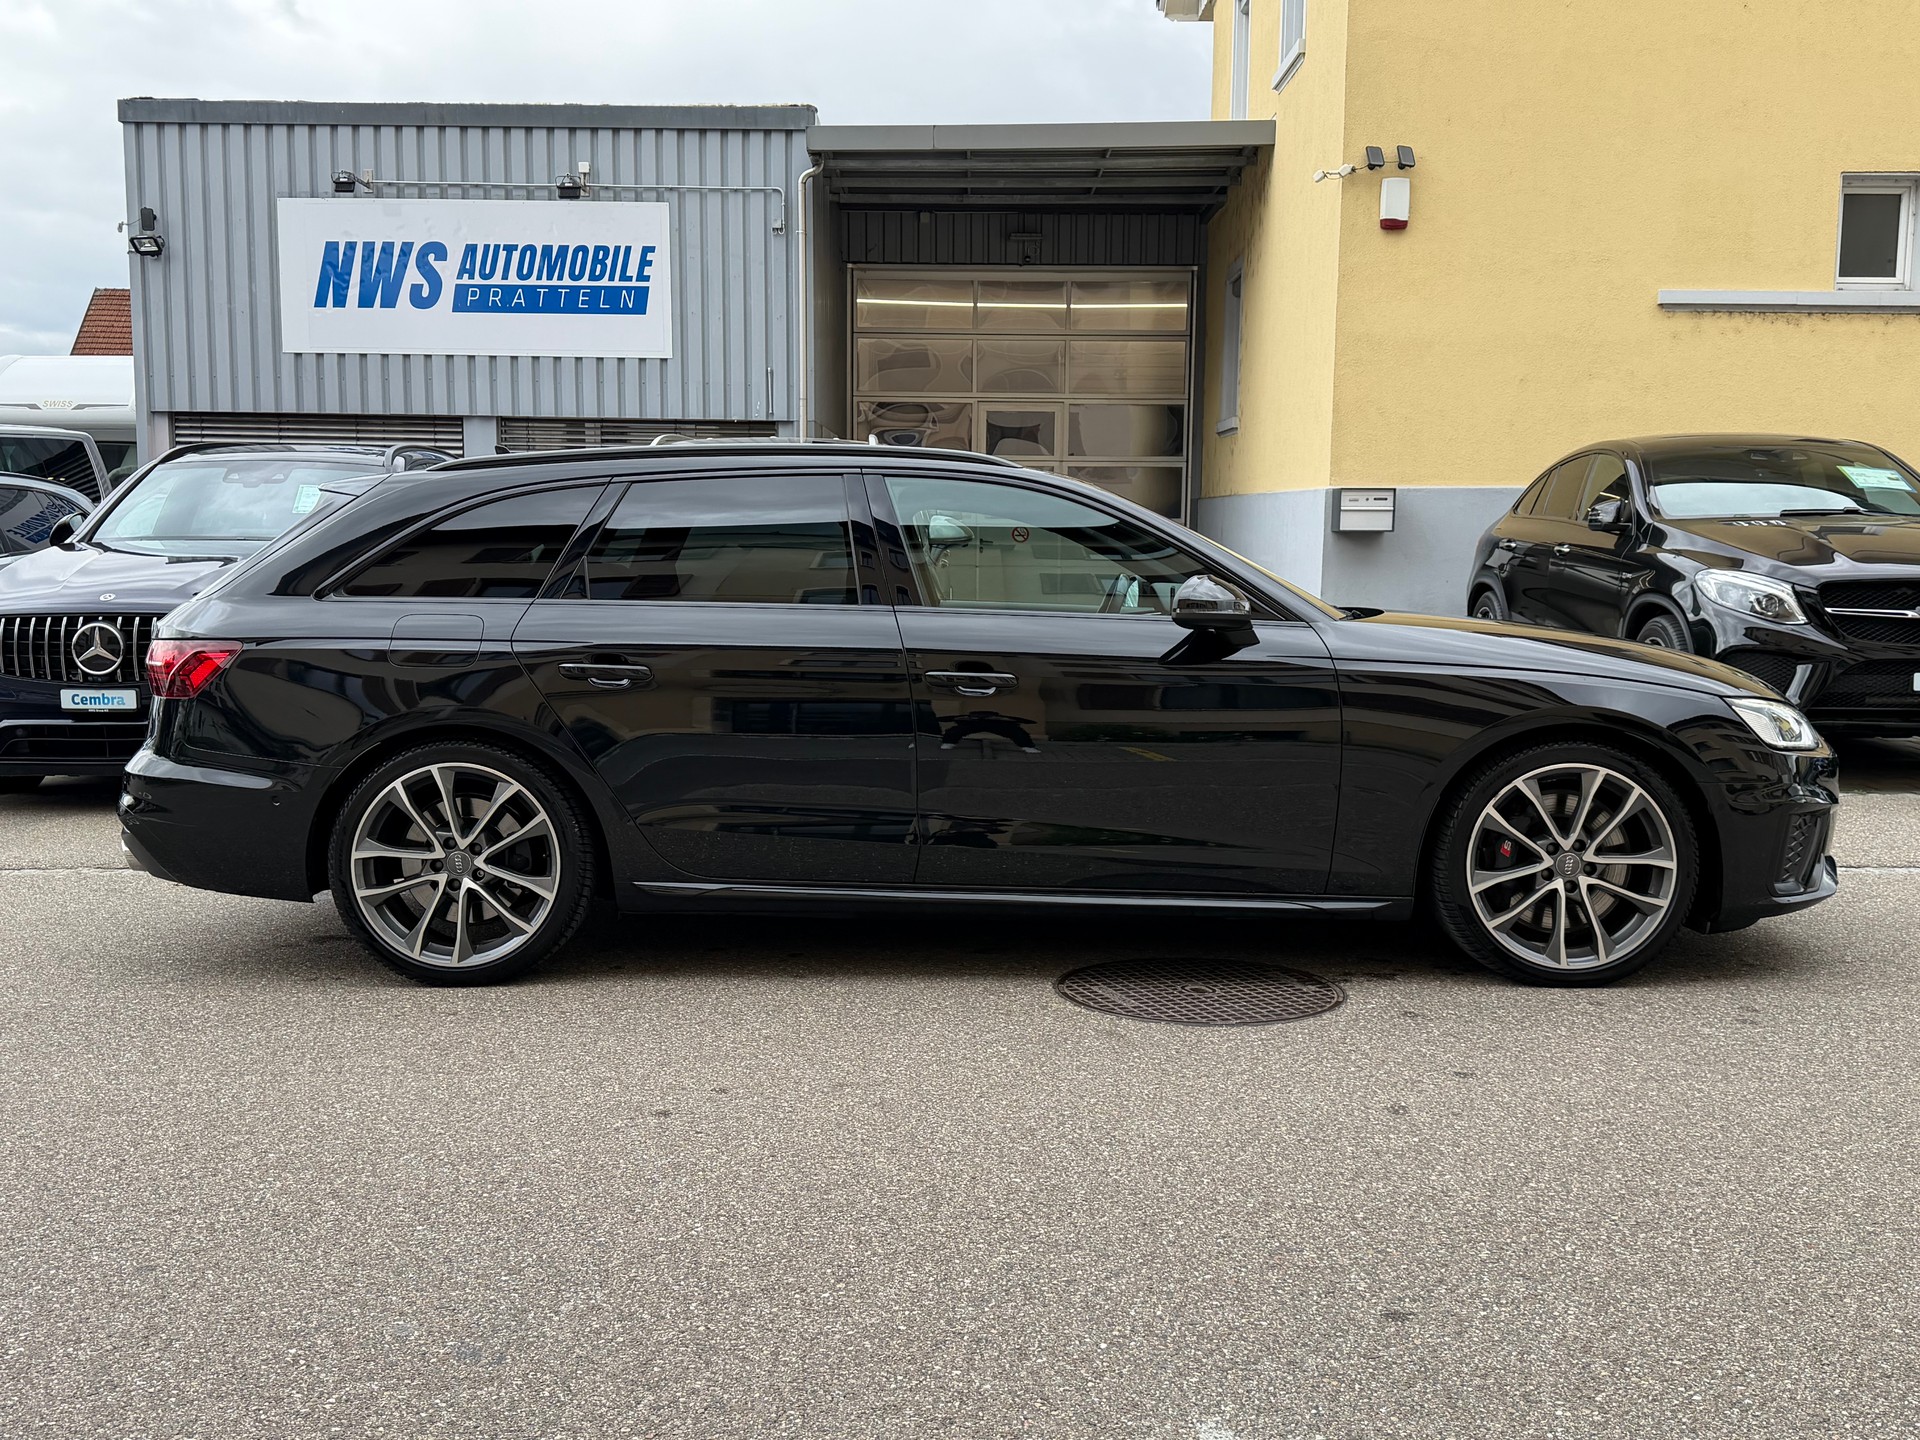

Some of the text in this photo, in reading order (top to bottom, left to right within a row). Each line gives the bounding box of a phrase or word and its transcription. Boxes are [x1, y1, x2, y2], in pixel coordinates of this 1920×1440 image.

[313, 241, 657, 309] NWS AUTOMOBILE
[466, 288, 635, 309] PRATTELN
[42, 400, 73, 408] SWISS
[71, 693, 126, 706] Cembra
